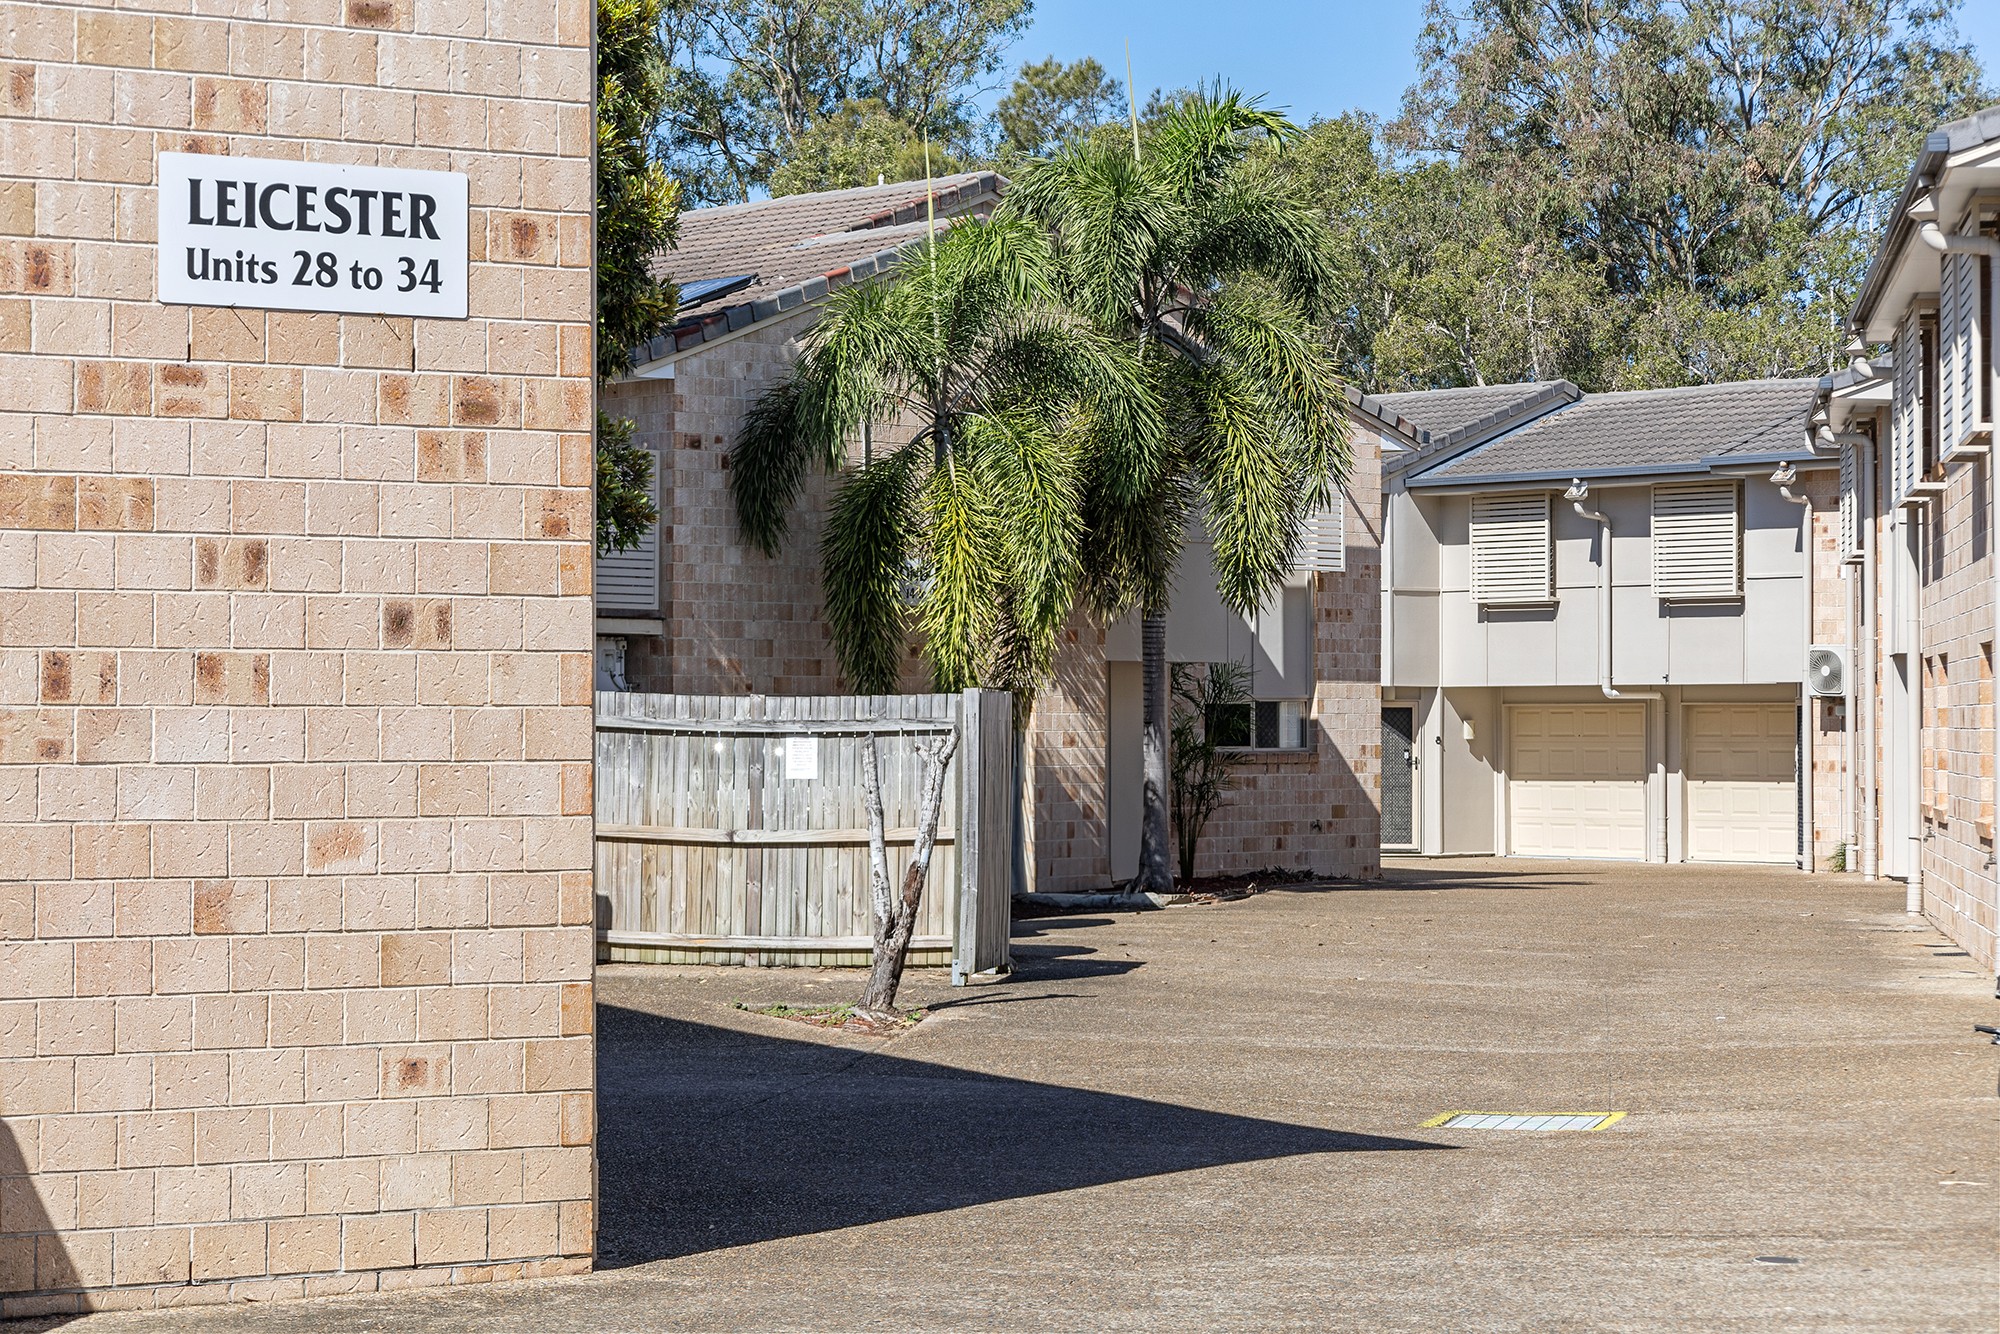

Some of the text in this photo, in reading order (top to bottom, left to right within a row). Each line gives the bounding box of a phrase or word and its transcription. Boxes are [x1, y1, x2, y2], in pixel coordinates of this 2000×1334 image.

[187, 178, 441, 240] LEICESTER
[186, 247, 443, 293] Units 28 to 34
